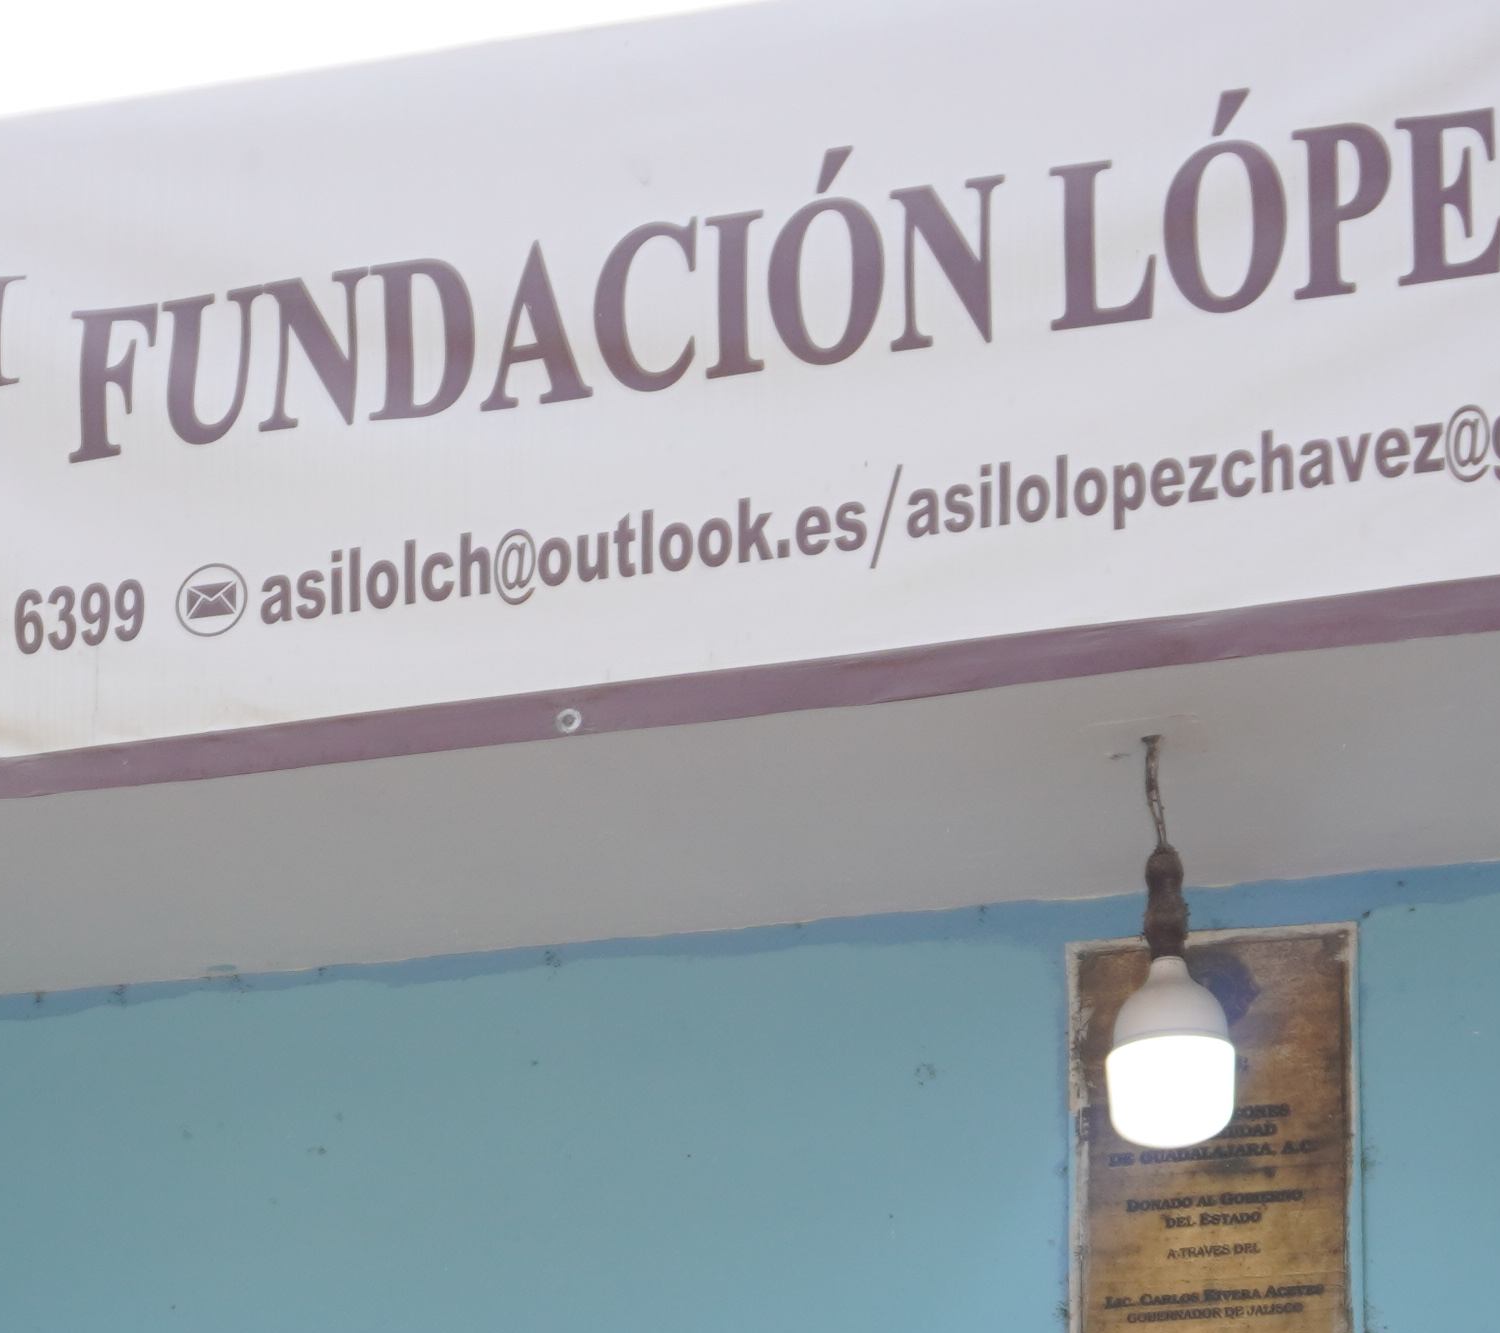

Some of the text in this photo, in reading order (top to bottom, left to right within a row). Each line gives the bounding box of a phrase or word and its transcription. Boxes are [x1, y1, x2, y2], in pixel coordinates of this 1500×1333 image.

[68, 149, 1003, 463] FUNDACIÓN
[14, 580, 145, 655] 6399
[1199, 1211, 1263, 1226] ESTADO
